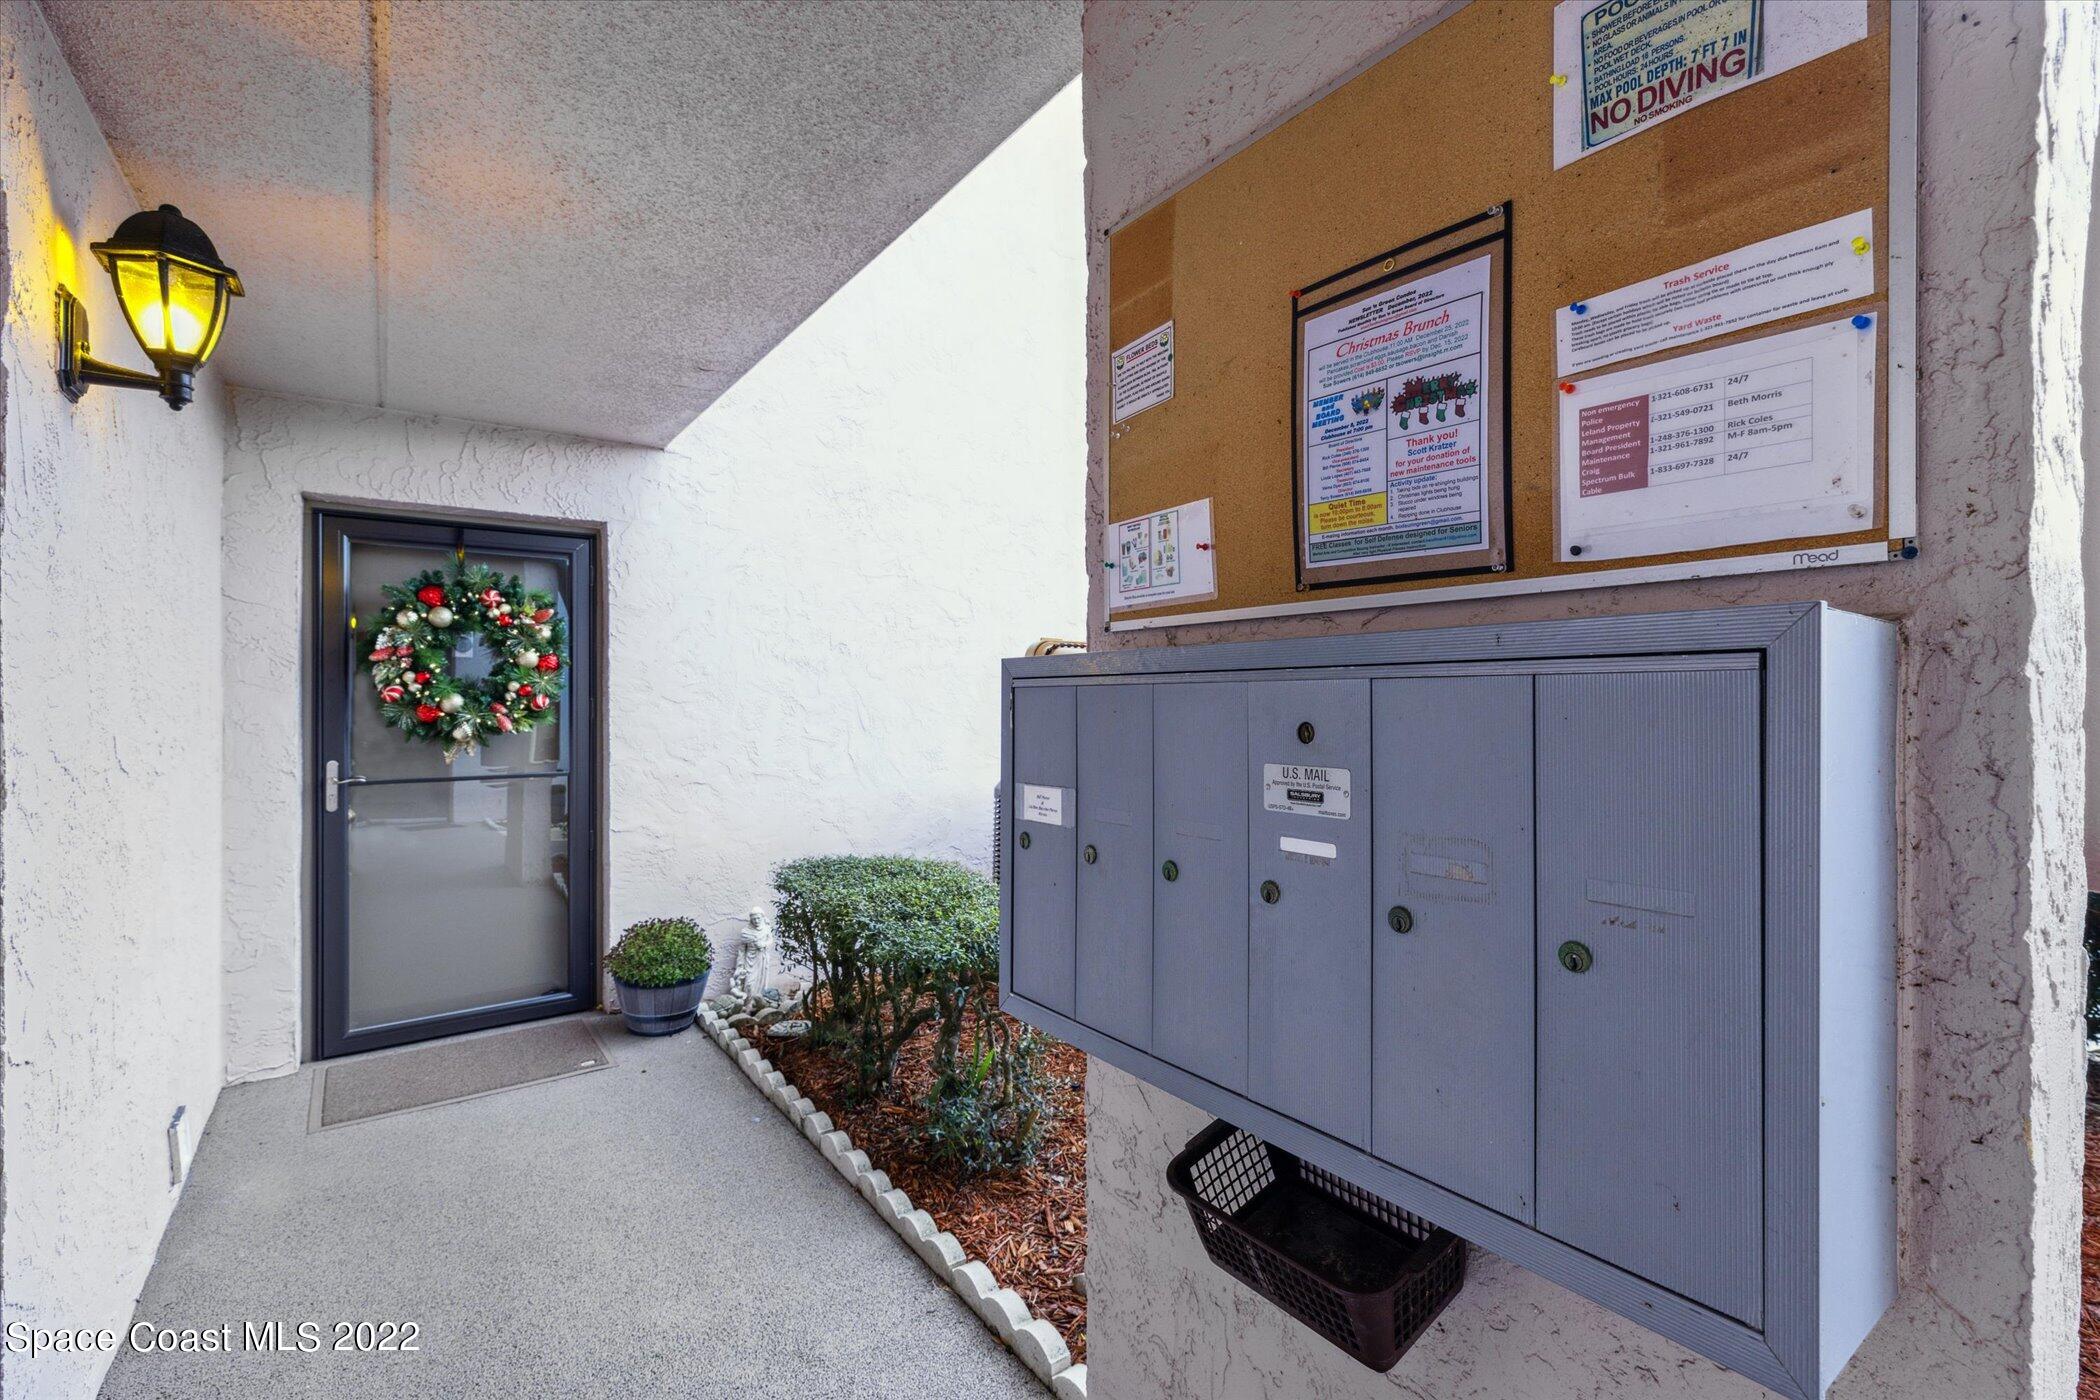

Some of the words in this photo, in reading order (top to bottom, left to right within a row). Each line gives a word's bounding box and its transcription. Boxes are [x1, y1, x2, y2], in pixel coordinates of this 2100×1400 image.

[1591, 15, 1621, 38] SHOWER
[1623, 0, 1651, 22] BEFORE
[1592, 36, 1602, 47] NO
[1603, 24, 1625, 42] GLASS
[1627, 18, 1636, 30] OR
[1637, 2, 1668, 24] ANIMALS
[1593, 55, 1603, 65] NO
[1605, 45, 1622, 59] FOOD
[1624, 40, 1634, 50] OR
[1634, 18, 1676, 45] BEVERAGES
[1687, 2, 1707, 19] POOL
[1590, 88, 1612, 109] MAX
[1616, 73, 1643, 97] POOL
[1647, 53, 1686, 83] DEPTH:
[1691, 48, 1697, 63] 7
[1702, 40, 1717, 59] FT
[1721, 35, 1728, 51] 7
[1733, 28, 1746, 47] IN
[1594, 60, 1612, 75] POOL
[1613, 51, 1628, 65] WET
[1594, 66, 1619, 84] BATHING
[1620, 56, 1639, 71] LOAD
[1594, 79, 1612, 92] POOL
[1649, 49, 1672, 66] HOURS
[1591, 97, 1631, 134] NO
[1637, 48, 1746, 114] DIVING
[1633, 114, 1647, 126] NO
[1648, 94, 1692, 120] SMOKING
[1663, 274, 1690, 290] Trash
[1693, 260, 1729, 280] Service
[1336, 329, 1399, 358] Christmas
[1403, 309, 1450, 337] Brunch
[1673, 321, 1692, 332] Yard
[1695, 312, 1721, 326] Waste
[1581, 408, 1596, 417] Non
[1598, 399, 1639, 415] emergency
[1727, 374, 1749, 386] 24/7
[1581, 426, 1605, 437] Leland
[1606, 419, 1640, 433] Property
[1727, 396, 1749, 407] Beth
[1751, 389, 1782, 402] Morris
[1581, 416, 1603, 427] Police
[1406, 433, 1434, 448] Thank
[1436, 428, 1458, 443] you!
[1407, 445, 1426, 456] Scott
[1428, 439, 1456, 452] Kratzer
[1581, 446, 1604, 456] Board
[1606, 439, 1640, 452] President
[1727, 418, 1746, 428] Rick
[1747, 413, 1773, 425] Coles
[1581, 431, 1630, 447] Management
[1582, 451, 1630, 466] Maintenance
[1727, 430, 1745, 440] M-F
[1747, 421, 1792, 437] 8am-5pm
[1390, 469, 1404, 477] new
[1406, 459, 1454, 474] maintenance
[1456, 454, 1476, 465] tools
[1395, 459, 1405, 467] for
[1407, 456, 1424, 466] your
[1425, 448, 1459, 461] donation
[1461, 445, 1470, 454] of
[1582, 474, 1616, 487] Spectrum
[1618, 470, 1635, 479] Bulk
[1727, 451, 1748, 462] 24/7
[1389, 478, 1412, 489] Activity
[1413, 474, 1437, 484] update:
[1582, 467, 1600, 477] Craig
[1328, 500, 1346, 510] Quiet
[1348, 497, 1365, 507] Time
[1582, 486, 1602, 495] Cable
[1404, 528, 1435, 540] designed
[1437, 526, 1447, 534] for
[1449, 522, 1477, 533] Seniors
[1793, 549, 1839, 565] mead
[1282, 767, 1301, 779] U.S.
[1304, 768, 1330, 782] MAIL
